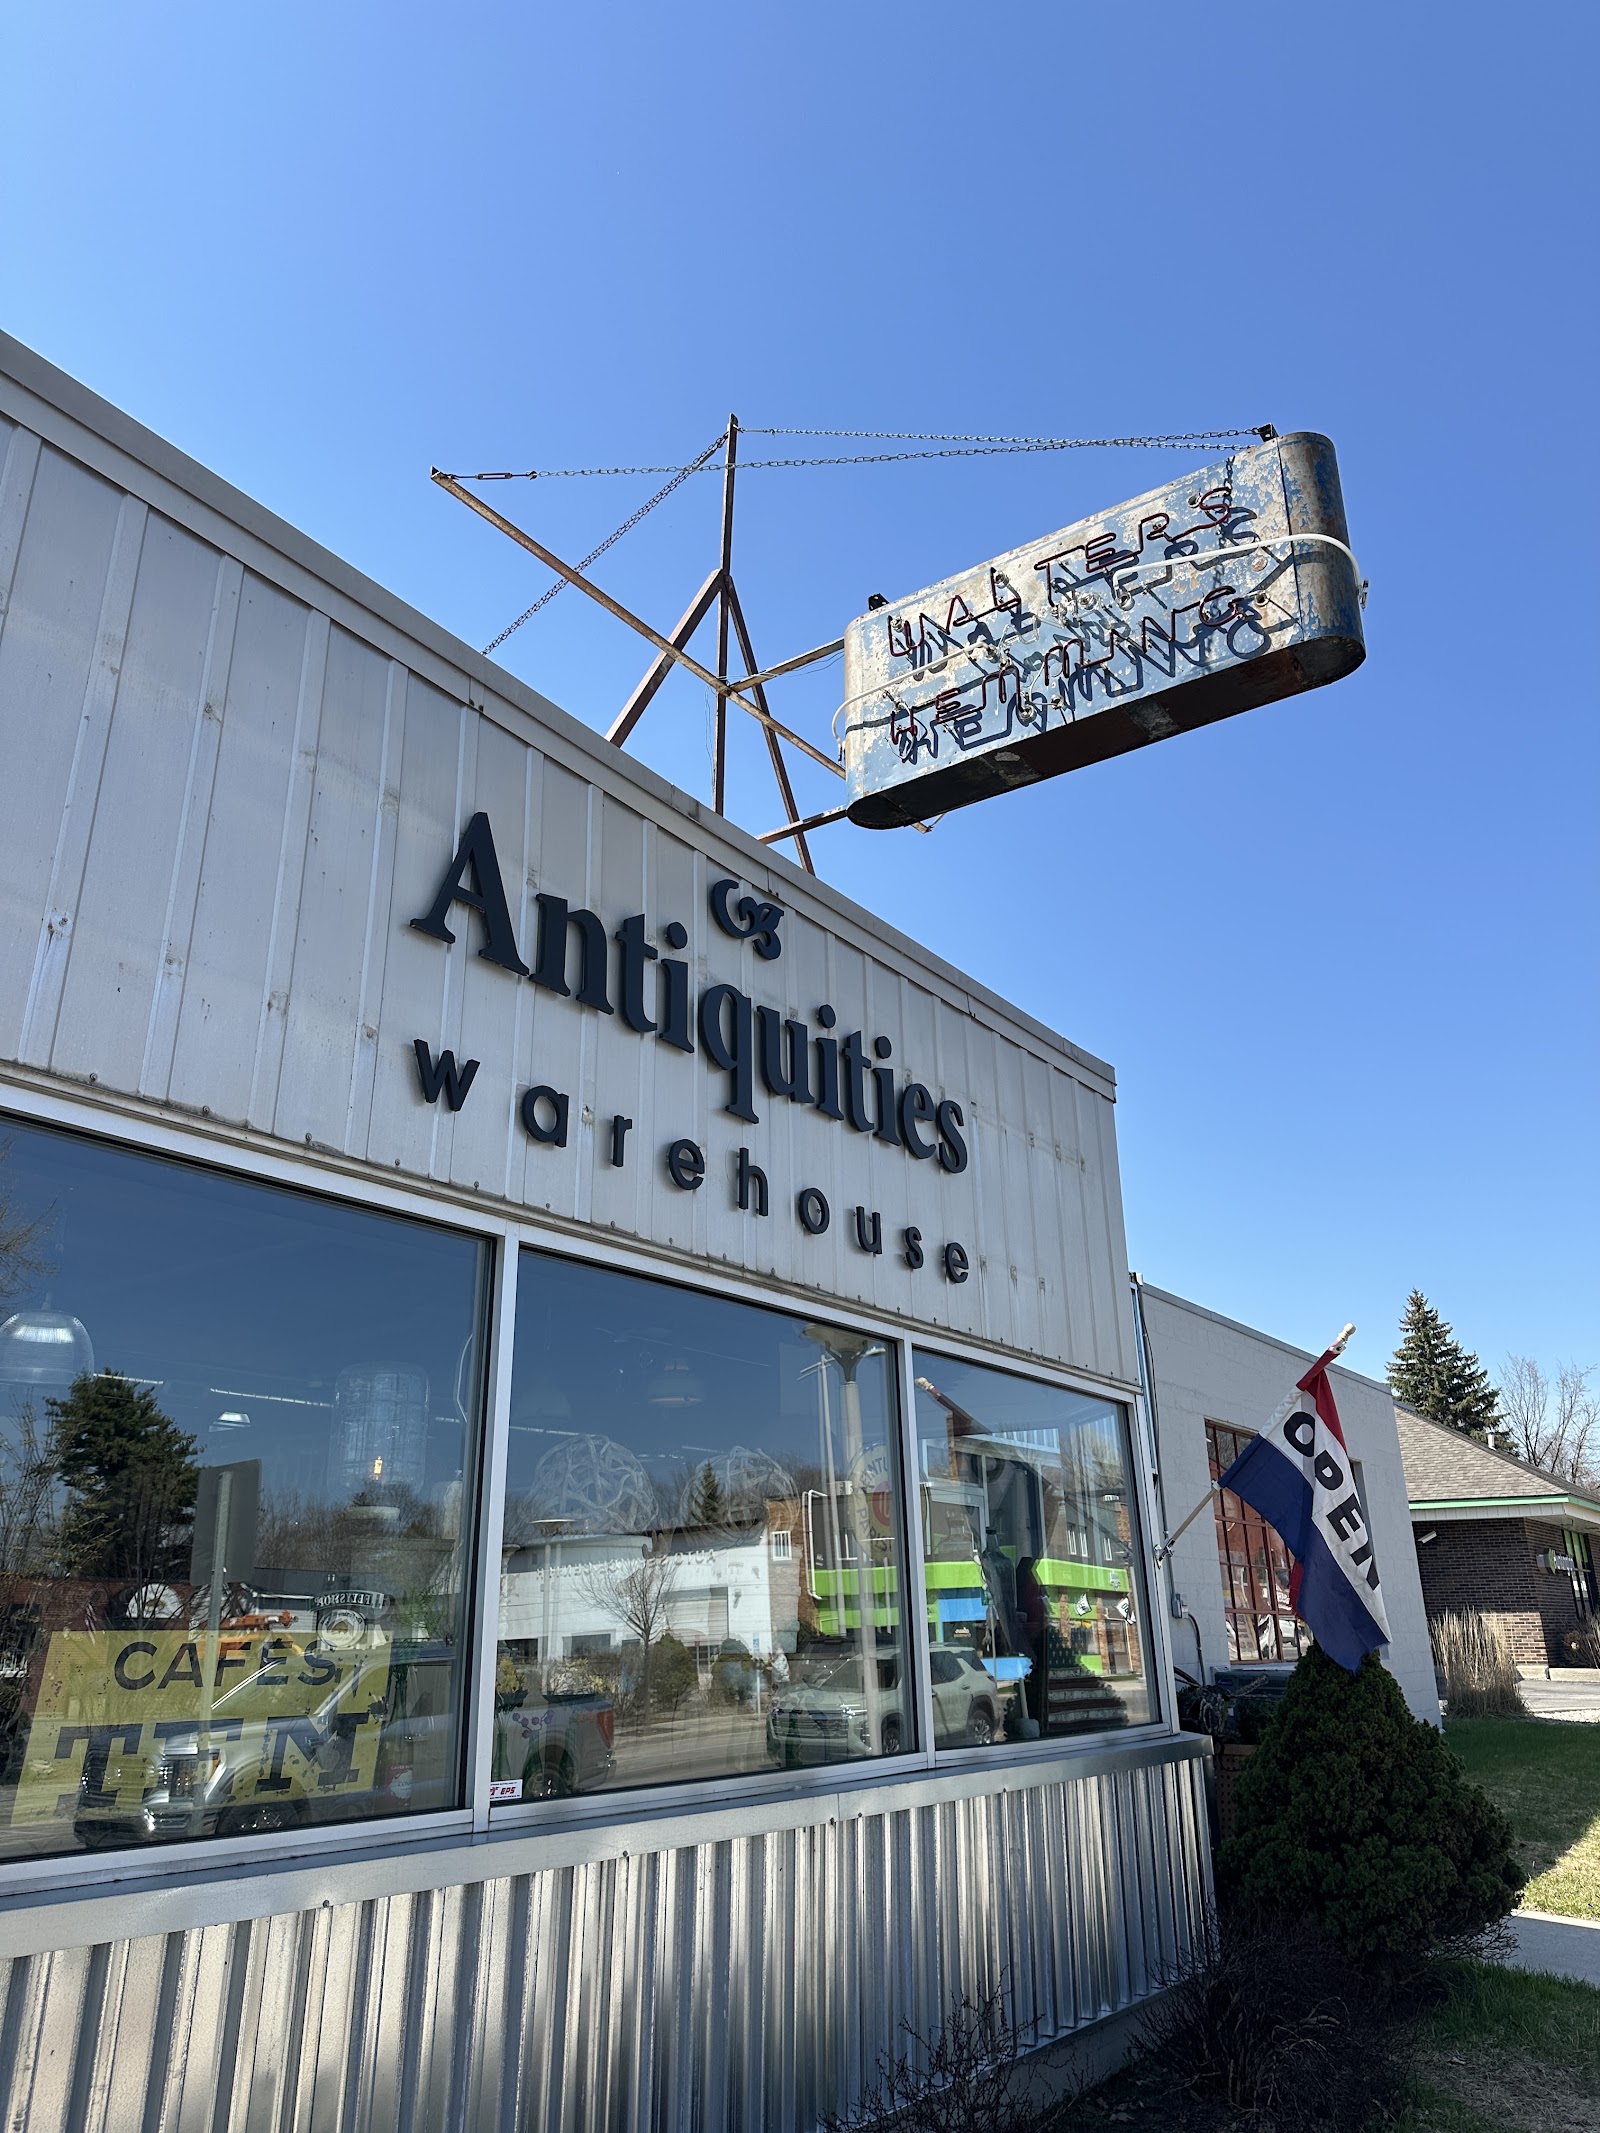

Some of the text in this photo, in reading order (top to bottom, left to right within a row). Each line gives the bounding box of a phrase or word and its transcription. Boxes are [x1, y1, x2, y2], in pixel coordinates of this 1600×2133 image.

[410, 811, 968, 1173] Antiquities
[413, 1038, 970, 1284] warehouse
[500, 1786, 516, 1795] EPS
